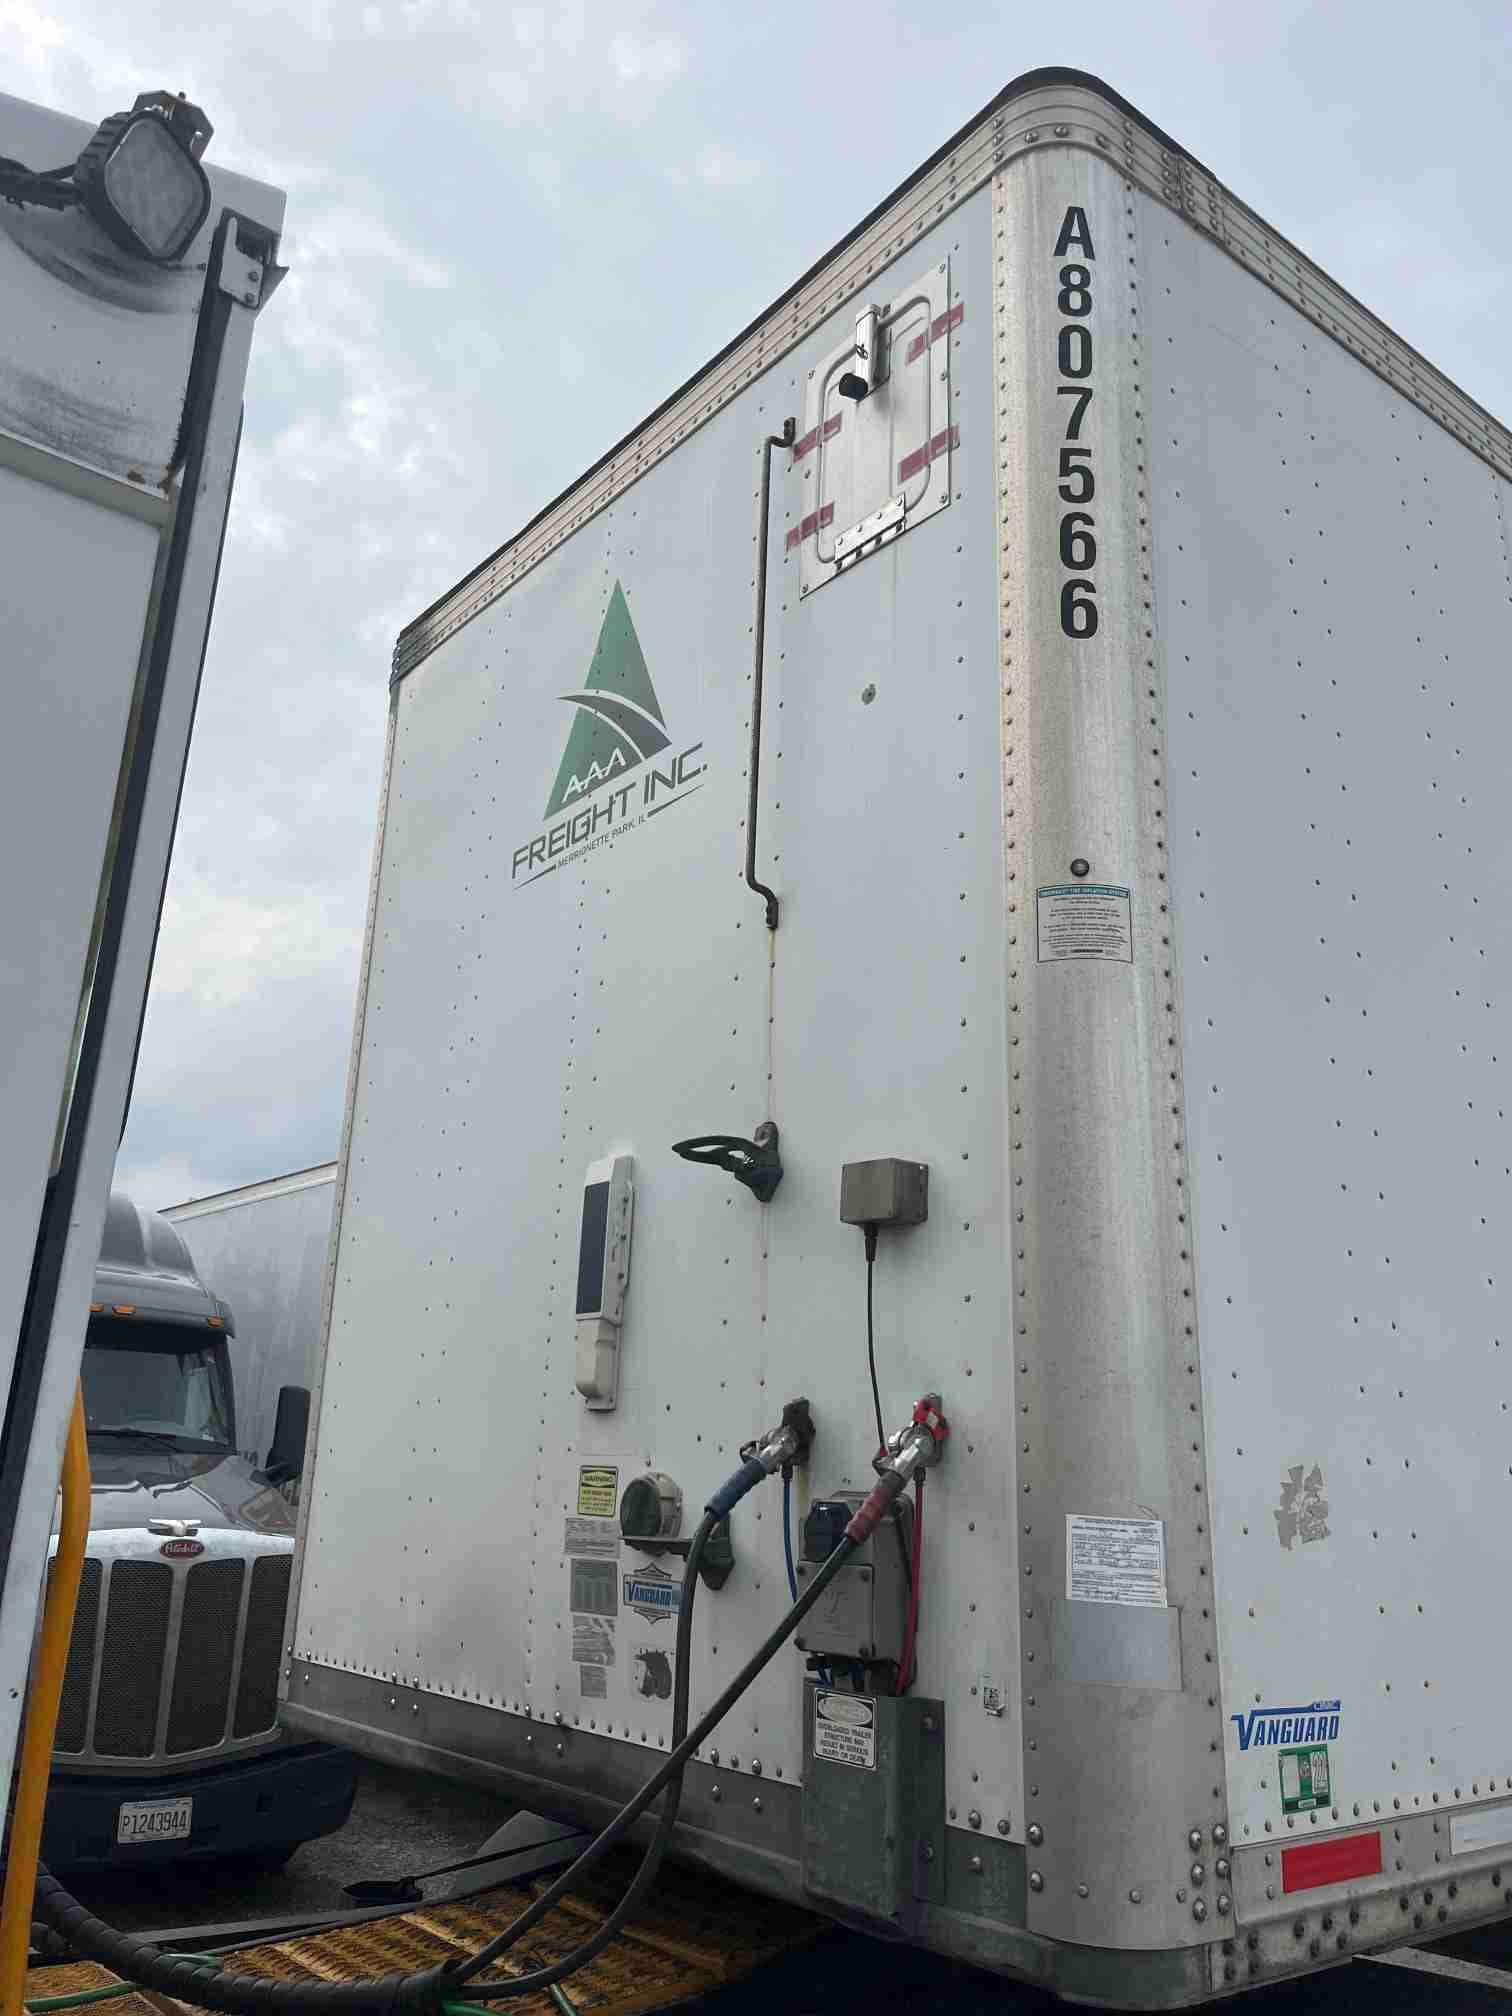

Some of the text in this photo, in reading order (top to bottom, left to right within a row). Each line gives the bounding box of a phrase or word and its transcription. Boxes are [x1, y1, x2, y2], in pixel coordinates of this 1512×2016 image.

[1053, 206, 1099, 640] A807566
[512, 742, 708, 879] FREIGHT INC.
[1231, 1709, 1340, 1751] VANGUARD
[122, 1810, 187, 1834] P1243944
